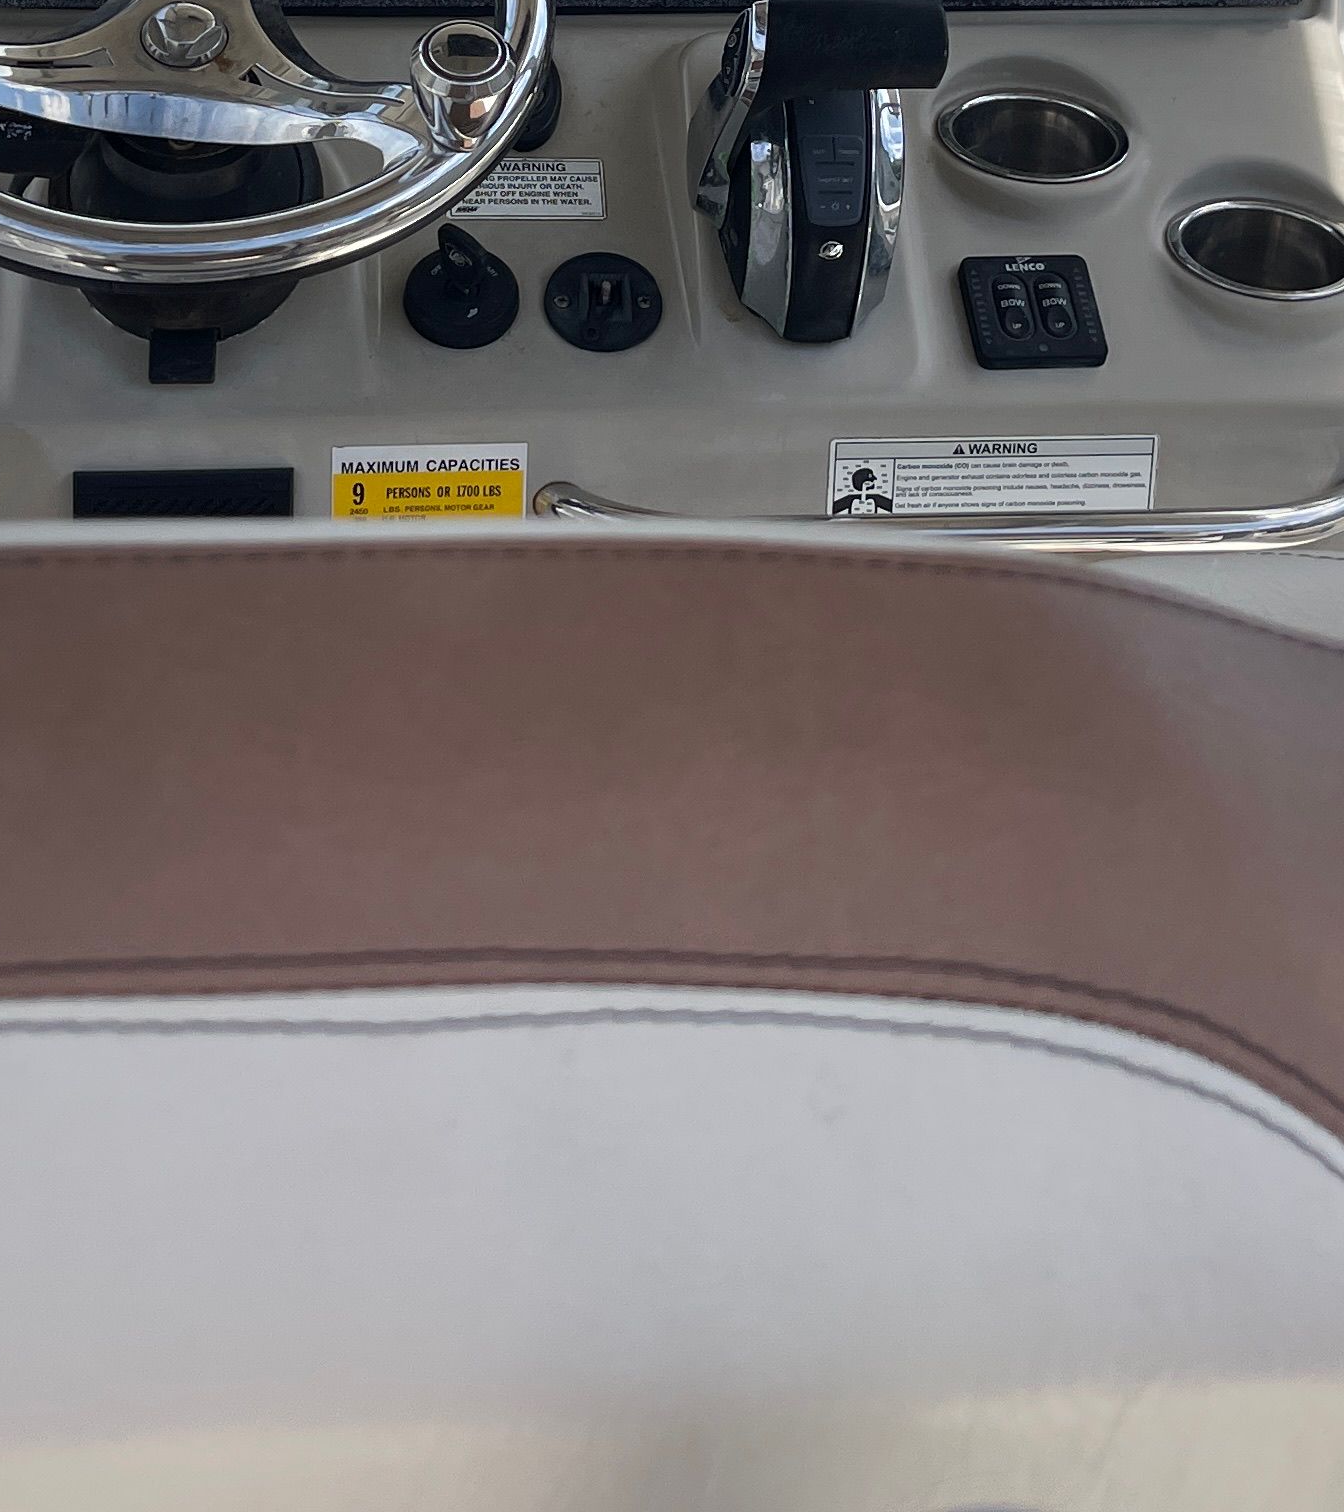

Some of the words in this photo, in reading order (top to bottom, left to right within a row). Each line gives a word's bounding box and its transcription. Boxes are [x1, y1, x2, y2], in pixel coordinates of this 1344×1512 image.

[499, 162, 566, 172] WARNING
[569, 175, 598, 183] CAUSE
[1006, 263, 1045, 273] LENCO
[1001, 299, 1025, 307] BOW
[1043, 298, 1067, 306] BOW
[969, 443, 1038, 454] WARNING
[342, 461, 419, 474] MAXIMUM
[426, 458, 520, 472] CAPACITIES
[352, 482, 365, 505] 9
[386, 487, 431, 499] PERSONS
[437, 486, 451, 498] OR
[456, 485, 480, 498] 1700
[483, 485, 502, 497] LBS
[473, 503, 495, 511] GEAR
